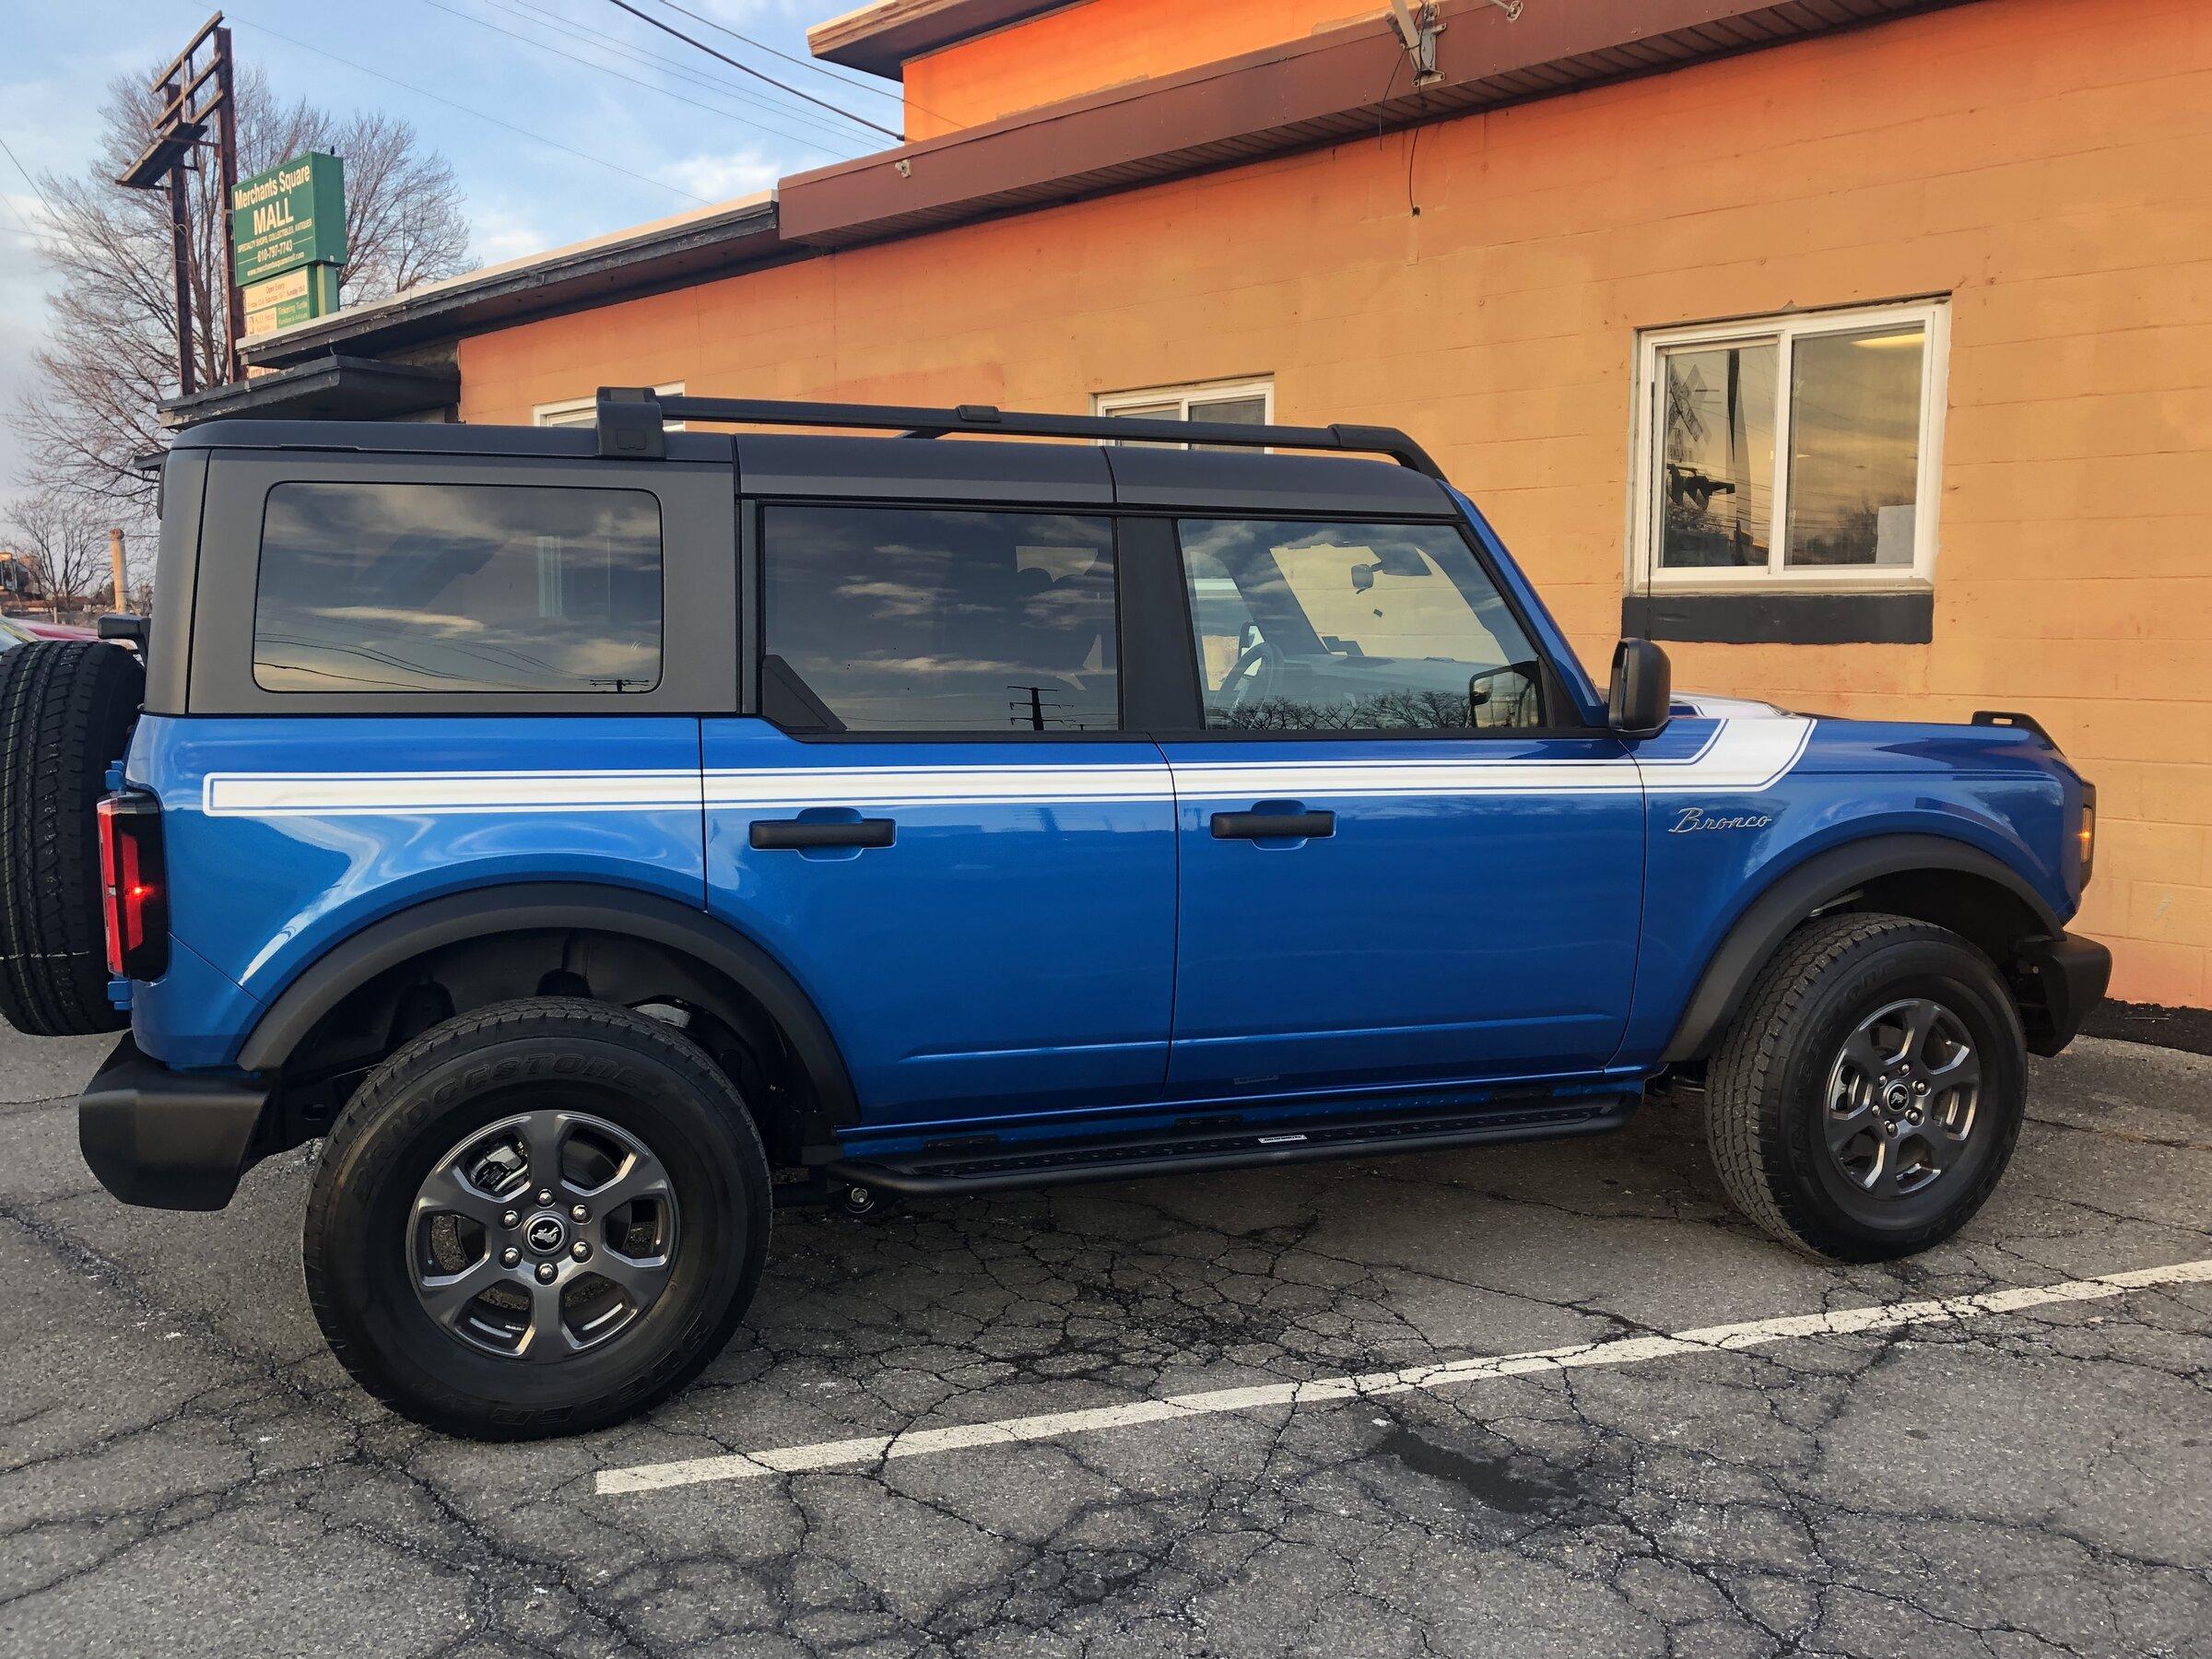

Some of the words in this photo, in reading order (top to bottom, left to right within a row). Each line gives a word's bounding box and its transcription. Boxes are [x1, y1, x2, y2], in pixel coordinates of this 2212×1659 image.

[234, 178, 278, 211] Merchants
[279, 165, 311, 194] Square
[253, 197, 294, 235] MALL
[1666, 806, 1772, 833] Bronco
